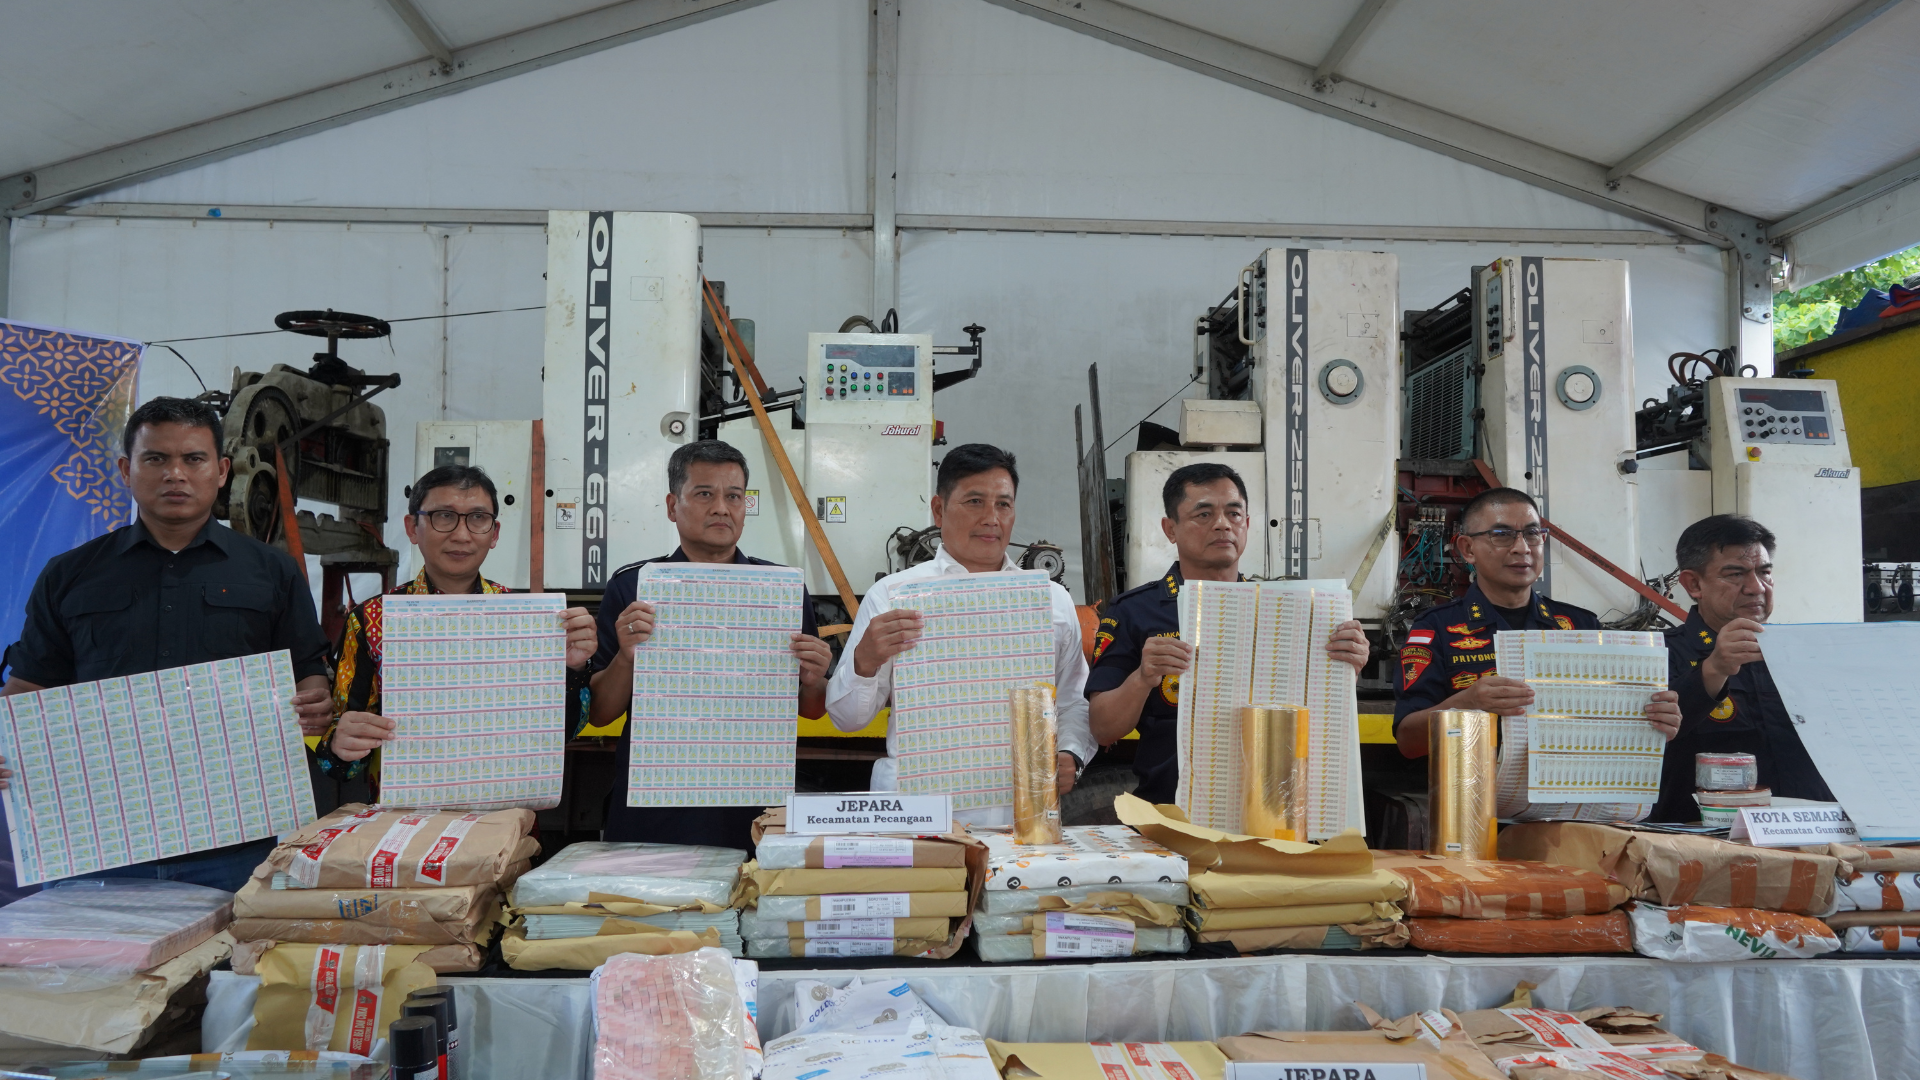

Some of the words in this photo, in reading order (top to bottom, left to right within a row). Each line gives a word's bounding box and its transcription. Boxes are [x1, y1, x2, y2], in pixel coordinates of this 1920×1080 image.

[881, 425, 920, 436] Sakurai
[1814, 468, 1850, 478] Sakurai
[836, 800, 903, 812] JEPARA
[807, 815, 870, 824] Kecamatan
[873, 815, 933, 826] Pecangaan
[1750, 812, 1791, 824] KOTA
[1794, 810, 1852, 822] SEMARA
[1762, 827, 1813, 836] Kecamatan
[1815, 826, 1857, 836] Gunungp
[1725, 924, 1778, 958] NEVIA
[357, 1006, 368, 1020] CUKAI
[355, 1019, 366, 1029] DAN
[364, 1026, 372, 1042] CUSTOMS
[1278, 1068, 1377, 1080] JEPARA
